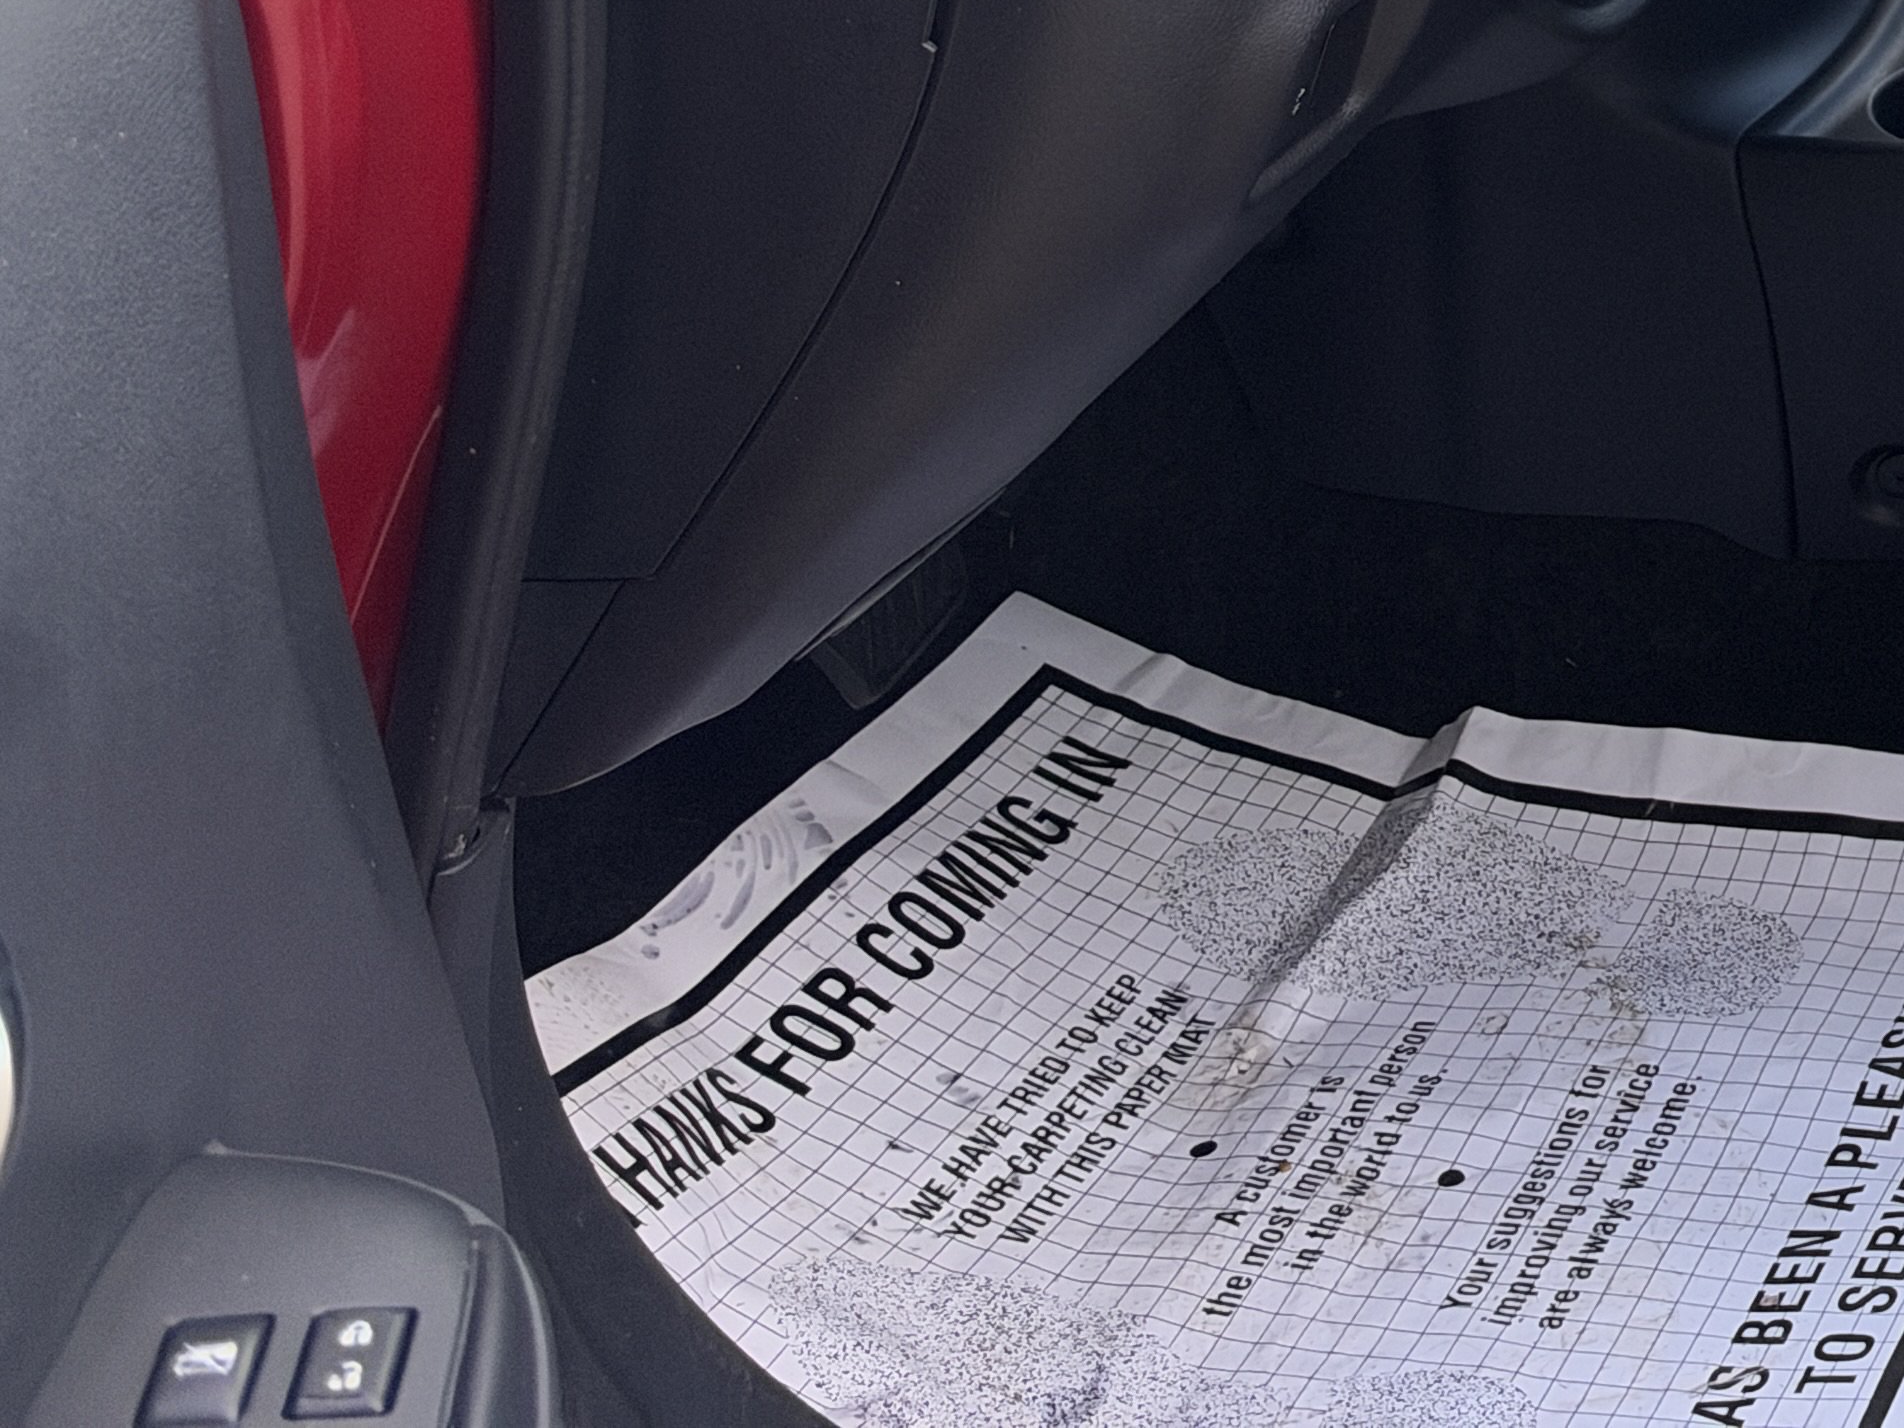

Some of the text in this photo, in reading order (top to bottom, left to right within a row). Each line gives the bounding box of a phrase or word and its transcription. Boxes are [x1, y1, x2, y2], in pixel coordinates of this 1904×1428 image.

[592, 735, 1132, 1229] HANKS FOR COMING IN
[902, 972, 1147, 1225] WE HAVE TRIED TO KEEP
[942, 1173, 1021, 1245] YOUR
[1004, 1053, 1128, 1177] CARPETING
[998, 1011, 1217, 1249] WITH THIS PAPER MAT
[1200, 1017, 1436, 1318] the most important person
[1216, 1073, 1345, 1228] A customer is
[1282, 1065, 1449, 1272] in the world to us.
[1439, 1061, 1612, 1316] Your suggestions for
[1480, 1059, 1662, 1330] improving our service
[1537, 1070, 1703, 1330] are always welcome.
[1731, 1229, 1843, 1345] BEEN
[1806, 1175, 1866, 1213] A
[1794, 1333, 1876, 1393] TO
